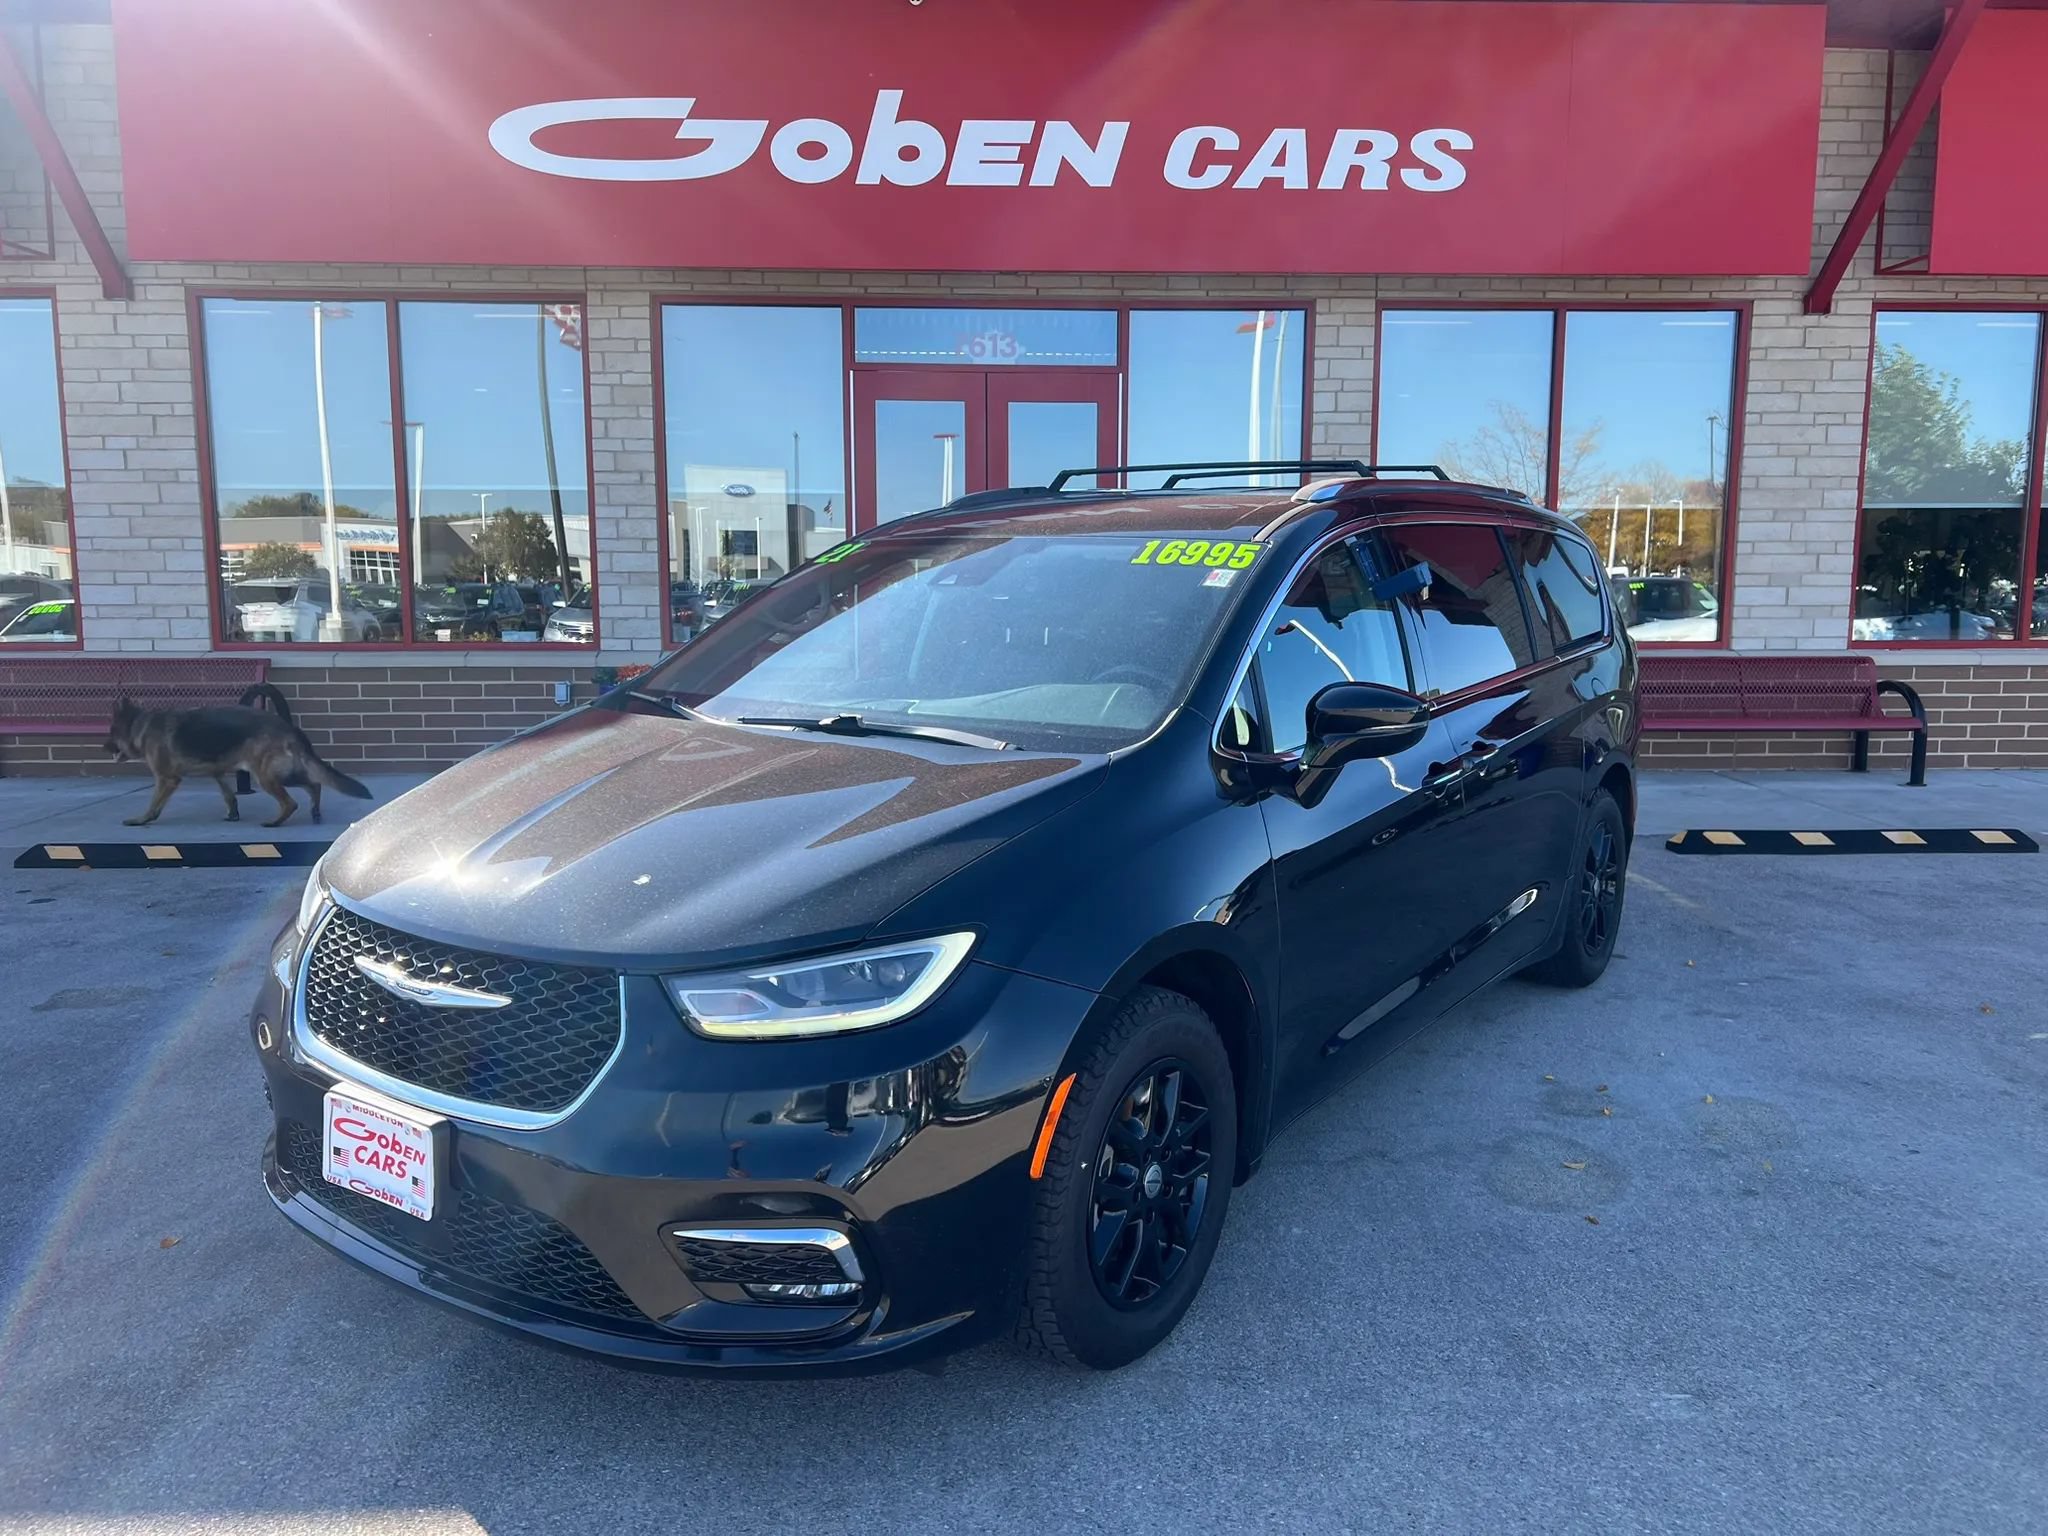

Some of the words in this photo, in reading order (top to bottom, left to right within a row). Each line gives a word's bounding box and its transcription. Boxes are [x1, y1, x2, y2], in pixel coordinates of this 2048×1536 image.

[1163, 125, 1474, 192] CARS
[1130, 540, 1262, 569] 16995
[352, 1104, 404, 1129] MIDDLETON
[354, 1145, 408, 1179] CARS
[326, 1174, 342, 1186] USA
[410, 1206, 425, 1219] USA
